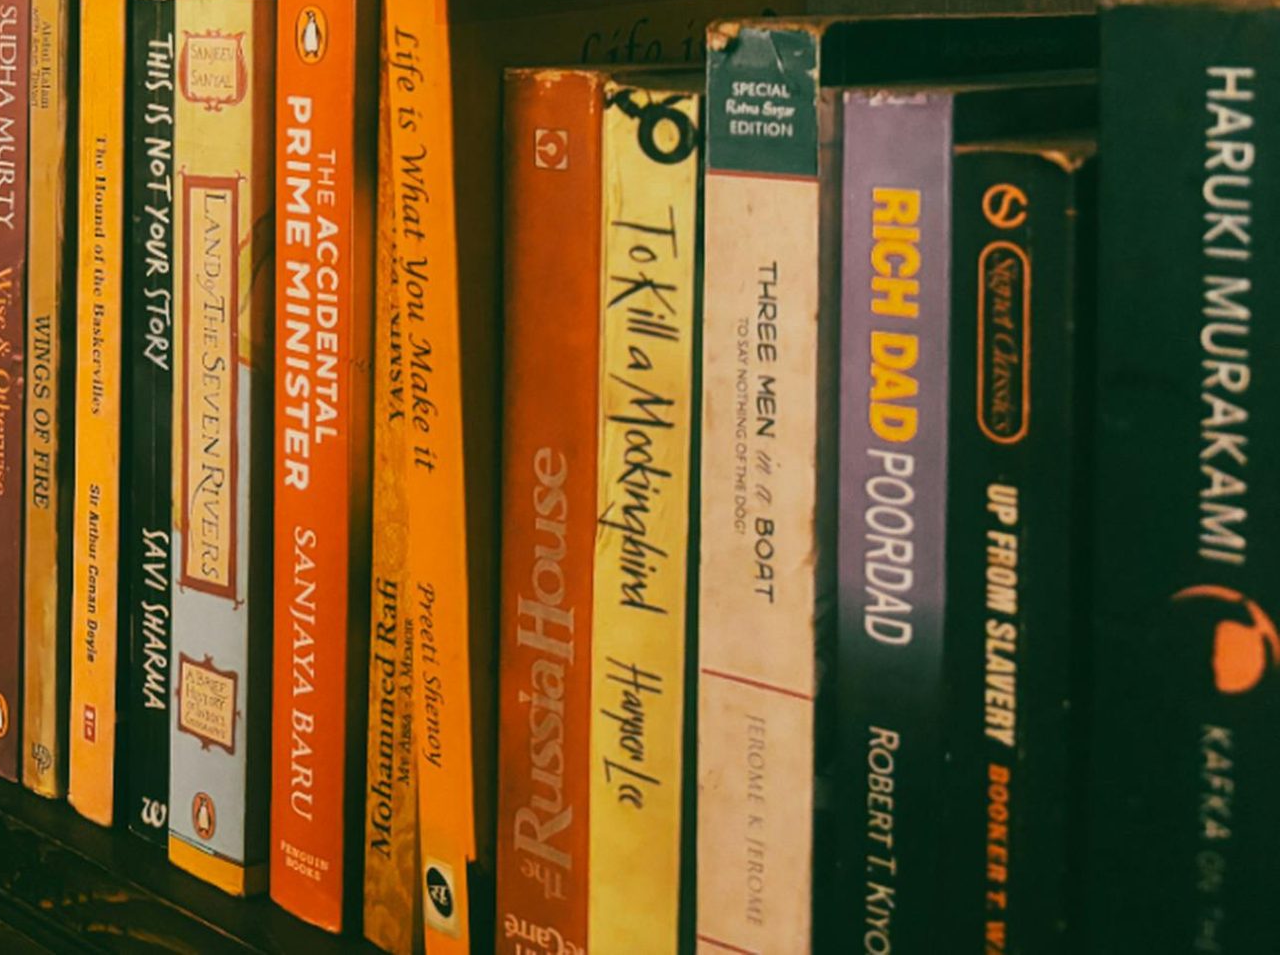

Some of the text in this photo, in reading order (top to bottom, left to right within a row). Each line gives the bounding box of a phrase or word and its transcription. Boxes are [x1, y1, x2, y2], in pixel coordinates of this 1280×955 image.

[728, 119, 795, 138] EDITION
[731, 80, 792, 100] SPECIAL
[89, 135, 107, 415] The Hound of the Baskervilles
[141, 31, 173, 372] THIS IS NOT YOUR STORY
[203, 191, 228, 278] LAND
[282, 96, 313, 491] PRIME MINISTER
[390, 25, 439, 474] Life is What You Make it
[869, 186, 921, 320] RICH
[314, 148, 339, 444] THE ACCIDENTAL
[867, 330, 920, 444] DAD
[1198, 65, 1257, 566] HARUKI MURAKAMI
[32, 315, 50, 510] WINGS OF FIRE
[201, 351, 227, 458] SEVEN
[598, 204, 681, 616] To Kill a Mockingbird
[734, 317, 750, 535] TO SAY NOTHING OF THE DOG!
[754, 261, 782, 604] THREE MEN in a BOAT
[85, 484, 100, 663] Sir Arthur Conan Doyle
[191, 463, 226, 579] RIVERS
[517, 447, 576, 664] House
[141, 527, 170, 710] SAVI SHARMA
[288, 525, 317, 822] SANJAYA BARU
[416, 581, 447, 769] Preeti Shenoy
[984, 483, 1019, 747] UP FROM SLAVERY
[370, 575, 399, 860] Mohammed Rafi
[514, 662, 574, 871] Russia
[603, 755, 663, 812] Lee
[867, 725, 900, 849] ROBERT
[1201, 723, 1235, 841] KAFKA
[279, 839, 330, 872] PENGUIN
[284, 855, 322, 882] BOOKS
[521, 857, 567, 900] The
[745, 713, 767, 929] JEROME JEROME
[866, 853, 897, 876] T.
[987, 763, 1011, 884] BOOKER
